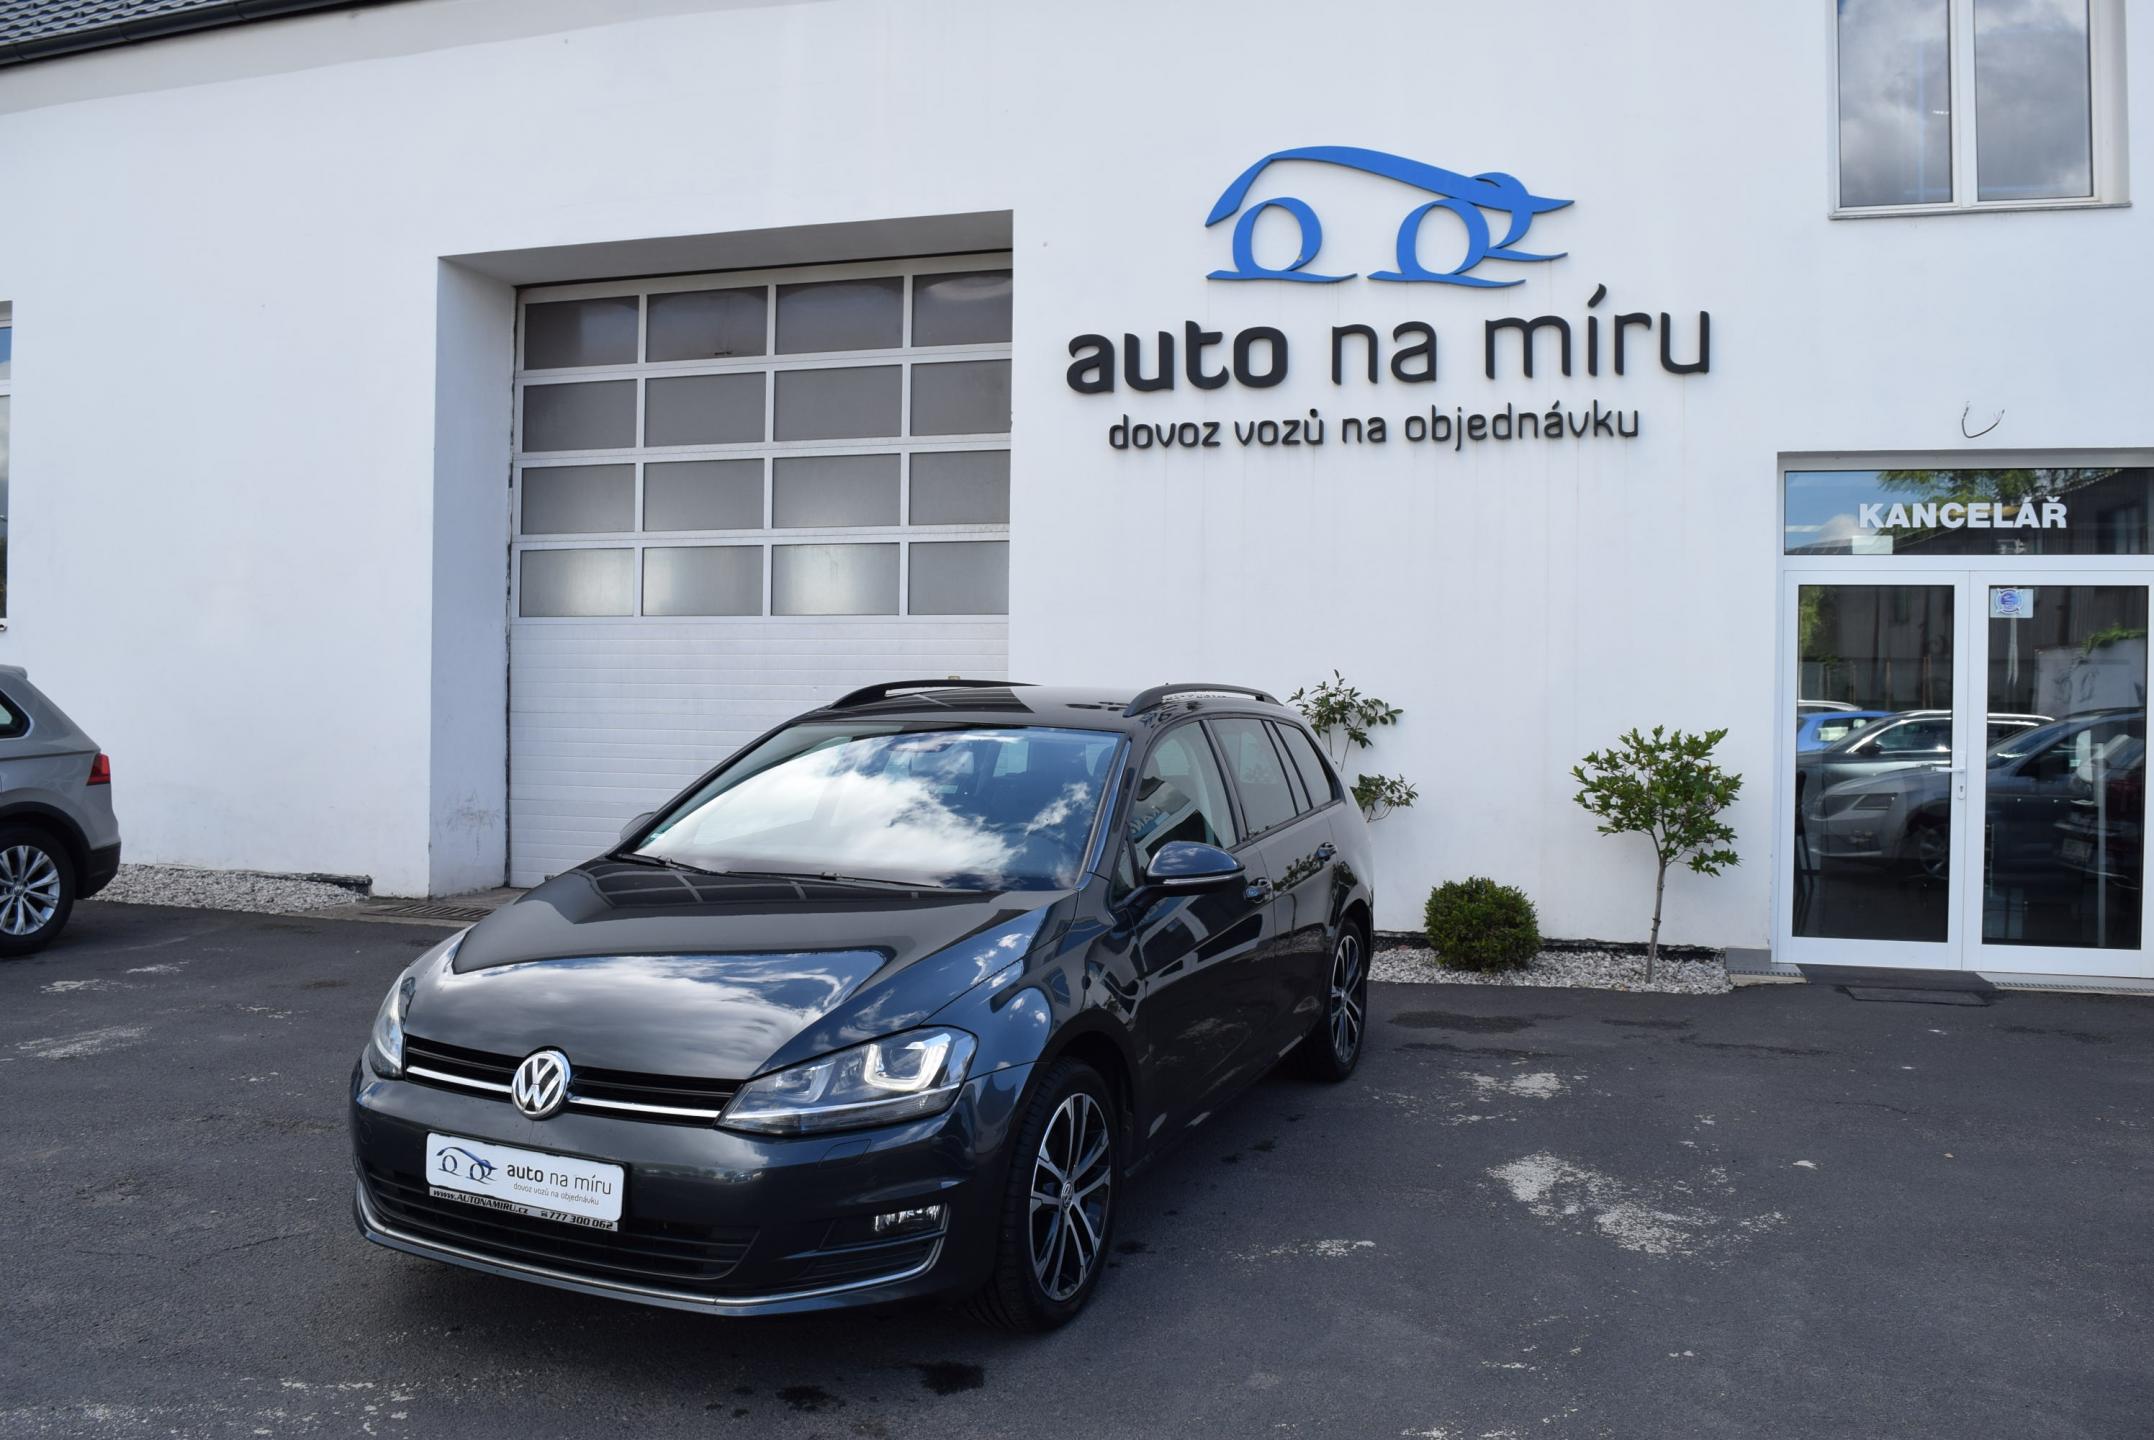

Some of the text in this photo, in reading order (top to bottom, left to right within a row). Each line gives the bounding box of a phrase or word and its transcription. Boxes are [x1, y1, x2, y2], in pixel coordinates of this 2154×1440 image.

[1066, 283, 1711, 395] auto na míru
[1109, 399, 1640, 452] dovoz vozů na objednávku
[1859, 496, 2067, 529] KANCELÁŘ
[507, 1164, 612, 1195] auto na míru
[513, 1182, 532, 1193] dovoz
